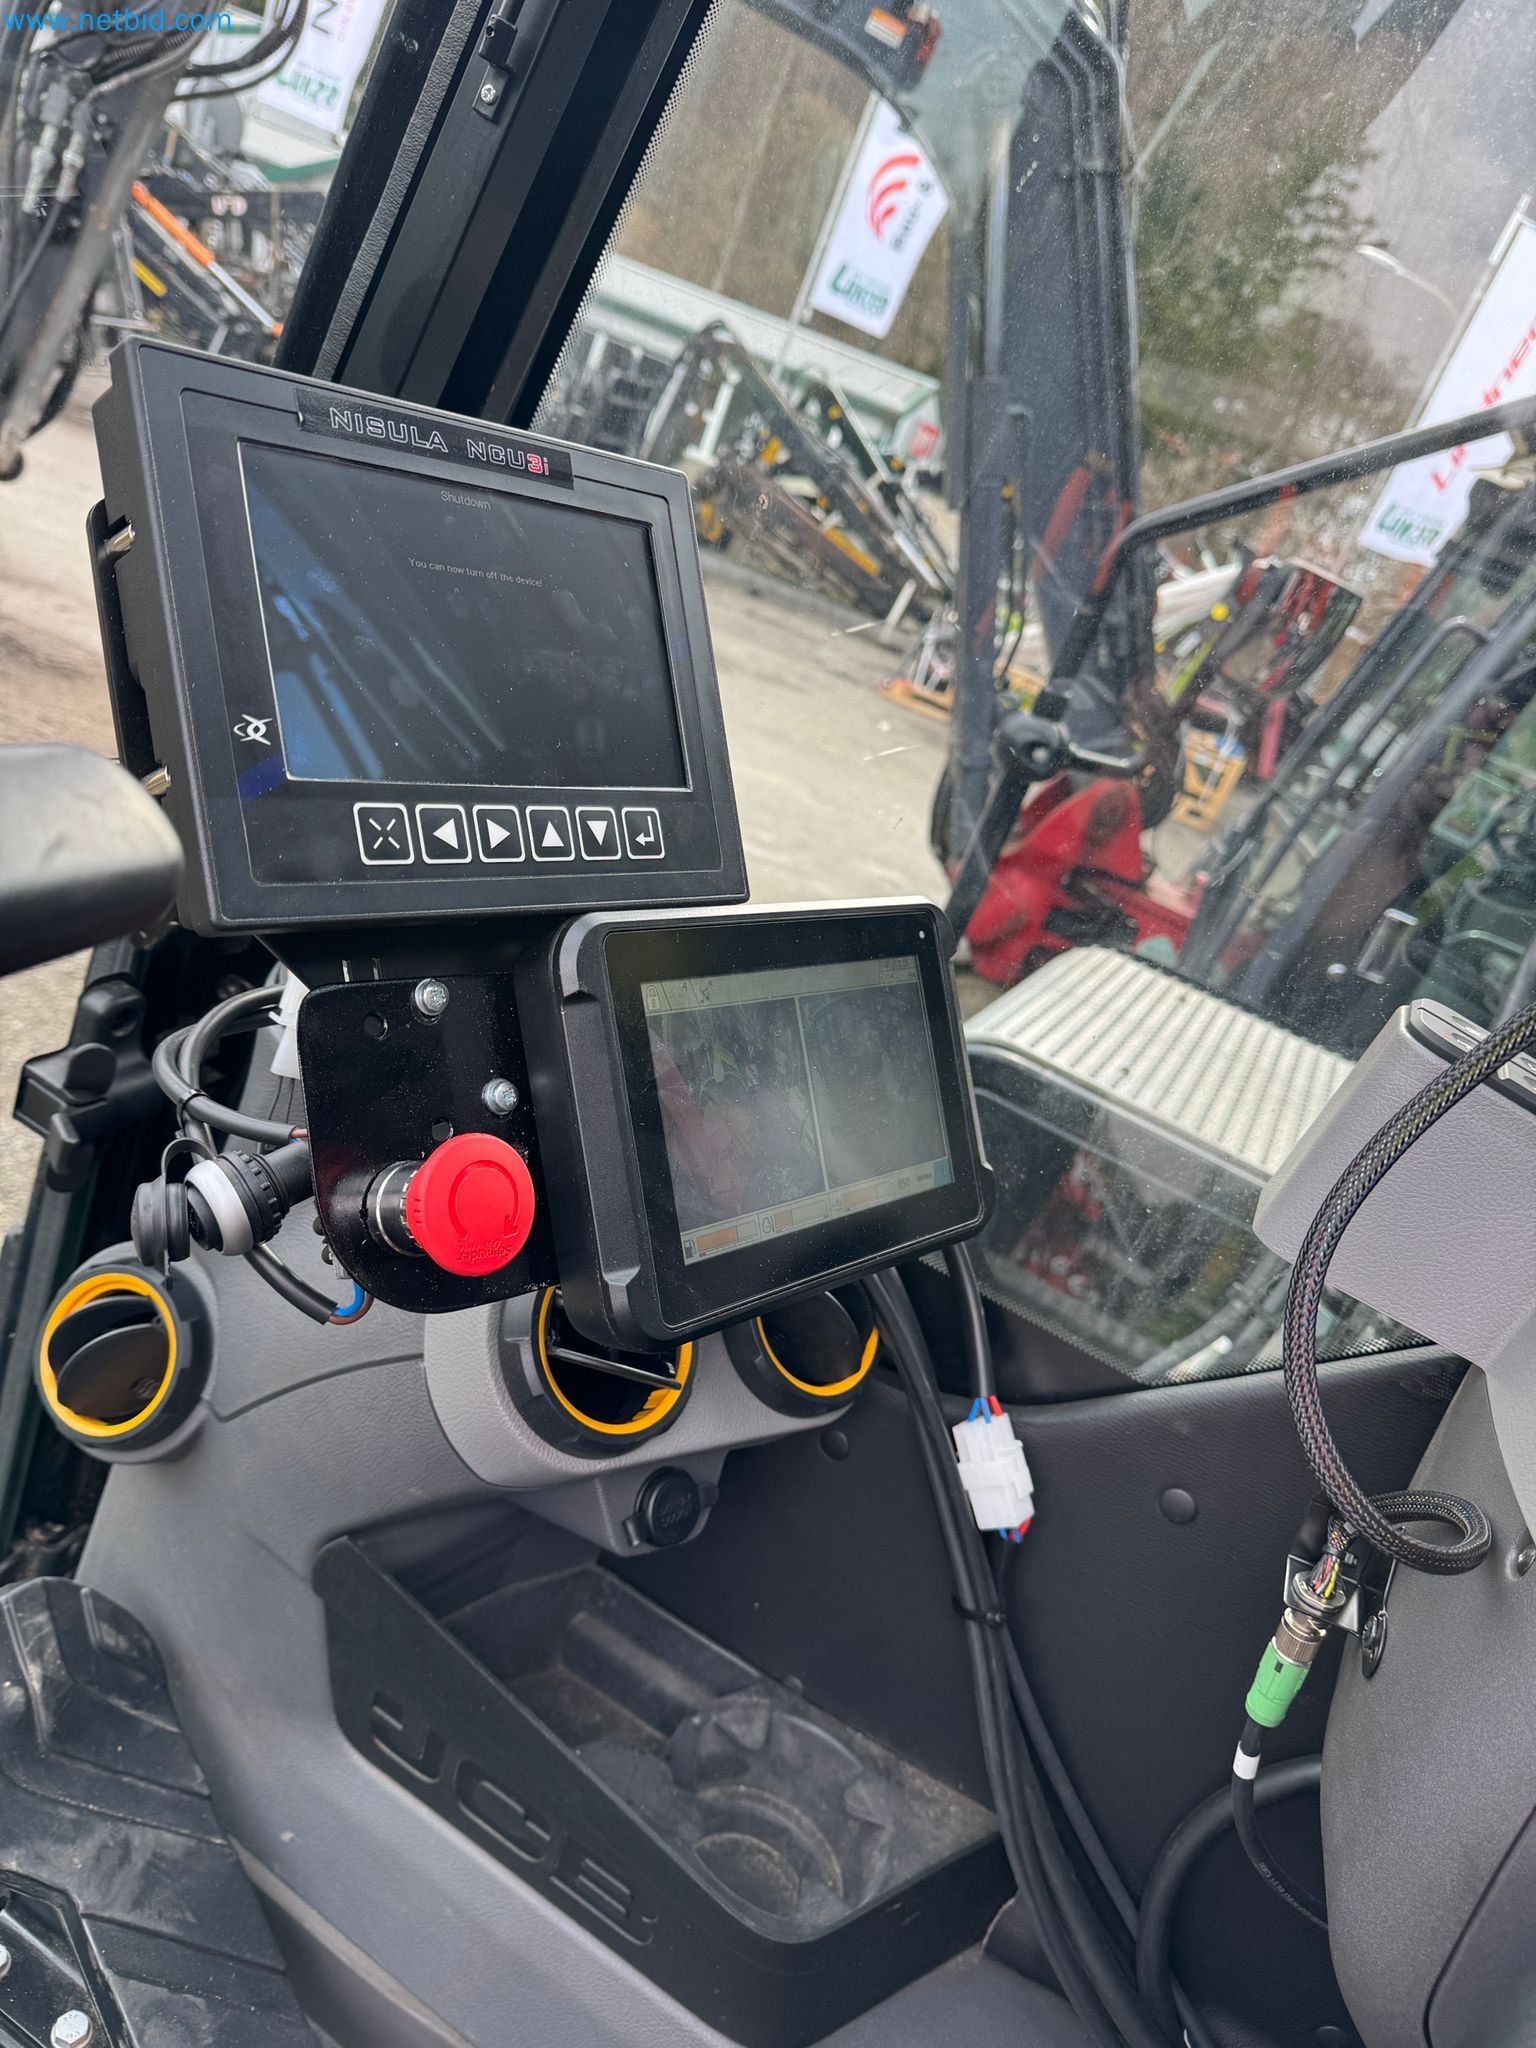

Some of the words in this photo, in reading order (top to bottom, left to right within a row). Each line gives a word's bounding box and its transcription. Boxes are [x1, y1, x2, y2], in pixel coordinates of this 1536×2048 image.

[330, 407, 449, 453] NISULA
[466, 438, 549, 476] NCU3i
[440, 490, 491, 511] Shutdown
[409, 557, 427, 569] You
[429, 562, 445, 572] can
[447, 565, 465, 575] now
[466, 568, 484, 578] turn
[486, 571, 498, 580] off
[500, 573, 514, 583] the
[516, 576, 543, 587] device!
[457, 1245, 512, 1263] Schneider
